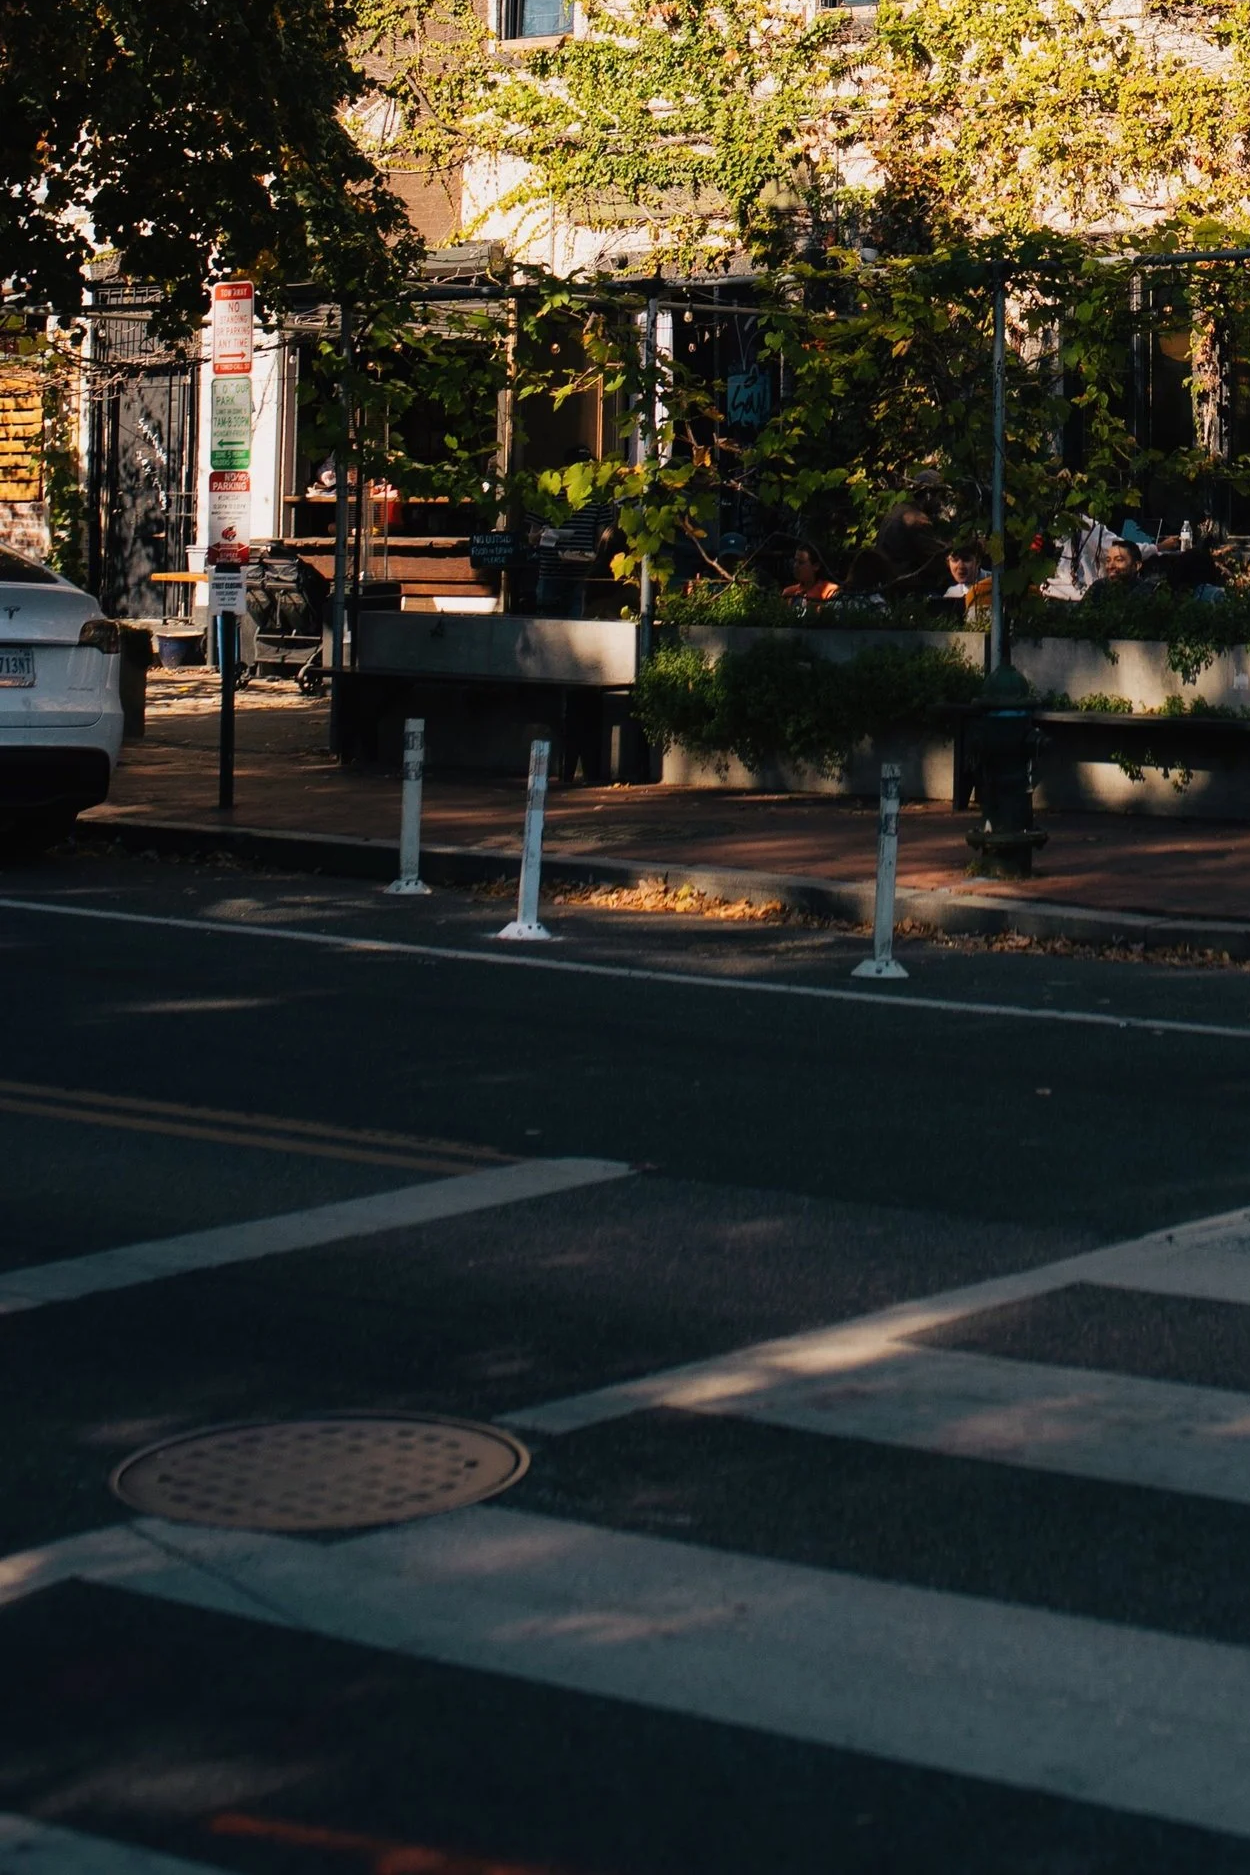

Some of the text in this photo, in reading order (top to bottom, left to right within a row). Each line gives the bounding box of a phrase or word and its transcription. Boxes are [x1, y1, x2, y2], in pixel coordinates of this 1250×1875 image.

[228, 301, 240, 313] NO
[219, 314, 248, 324] STANDING
[226, 326, 250, 335] PARKING
[218, 338, 248, 349] ANY TIME
[211, 383, 250, 394] TO OUR
[212, 481, 247, 491] PARKING
[473, 534, 514, 544] NO OUTSID
